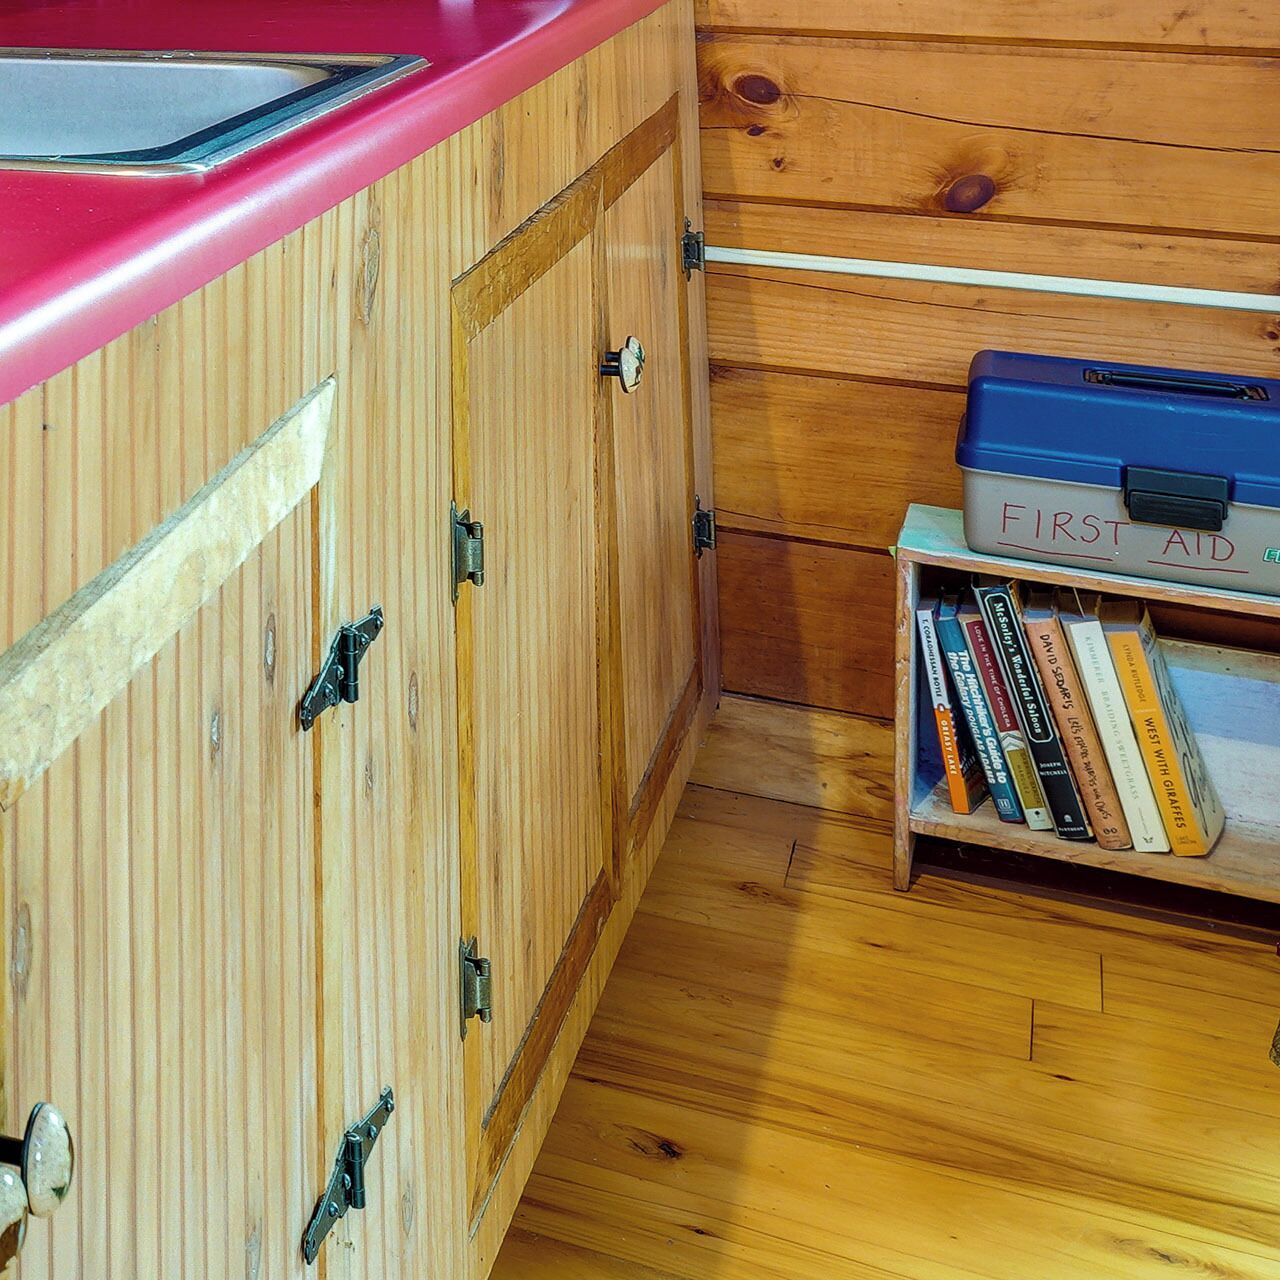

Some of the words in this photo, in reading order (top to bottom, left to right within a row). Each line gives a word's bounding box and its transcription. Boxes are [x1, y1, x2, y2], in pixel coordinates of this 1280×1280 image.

[1002, 502, 1130, 546] FIRST
[1162, 529, 1236, 562] AID
[946, 651, 958, 670] the
[953, 670, 972, 710] Galaxy
[974, 625, 983, 643] LOVE
[988, 668, 997, 685] TIME
[997, 696, 1011, 728] CHOLERA
[994, 602, 1016, 653] McSorley's
[1011, 654, 1034, 701] Wonderful
[1040, 634, 1063, 665] DAVID
[1052, 666, 1075, 710] SEDARIS
[940, 719, 954, 752] GREASY
[957, 650, 971, 672] The
[966, 672, 992, 736] Hitchhiker's
[984, 733, 1002, 770] Guide
[995, 770, 1008, 785] to
[963, 710, 984, 752] DOUGLAS
[977, 751, 997, 785] ADAMS
[1101, 691, 1120, 737] BRAIDING
[1116, 739, 1140, 800] SWEETGRASS
[946, 753, 958, 776] LAKE
[1143, 717, 1161, 745] WEST
[1153, 748, 1170, 776] WITH
[1163, 780, 1188, 829] GIRAFFES
